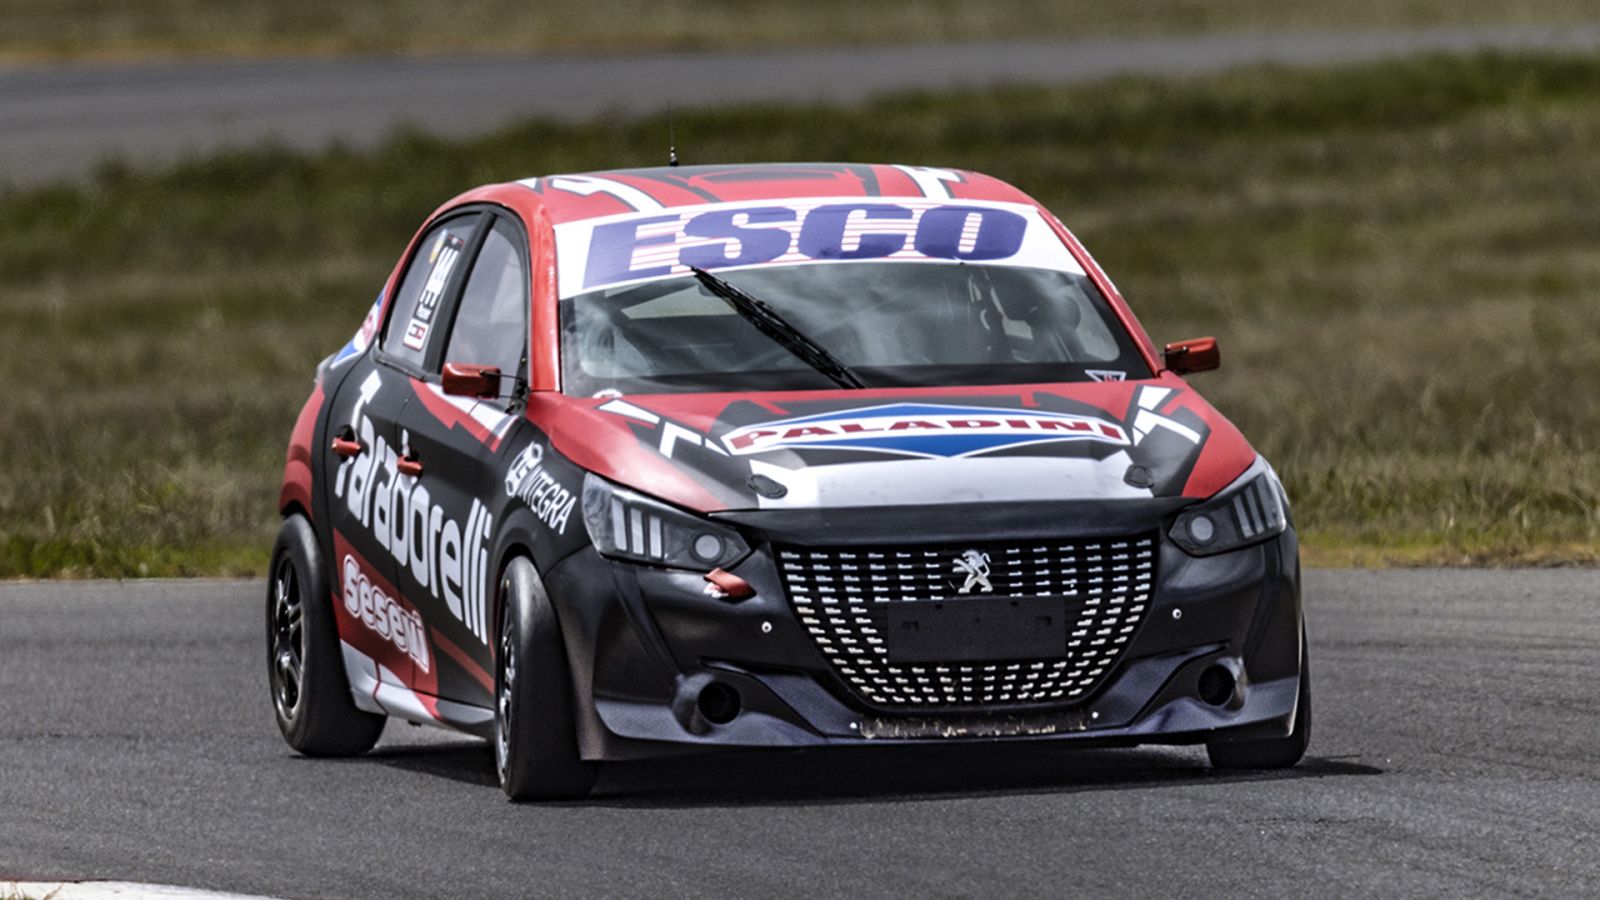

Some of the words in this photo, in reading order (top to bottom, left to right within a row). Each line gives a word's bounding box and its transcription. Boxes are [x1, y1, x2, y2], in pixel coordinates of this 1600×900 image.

[582, 203, 1028, 290] ESCO
[729, 418, 1123, 451] PALADINI
[516, 464, 577, 535] INTEGRA
